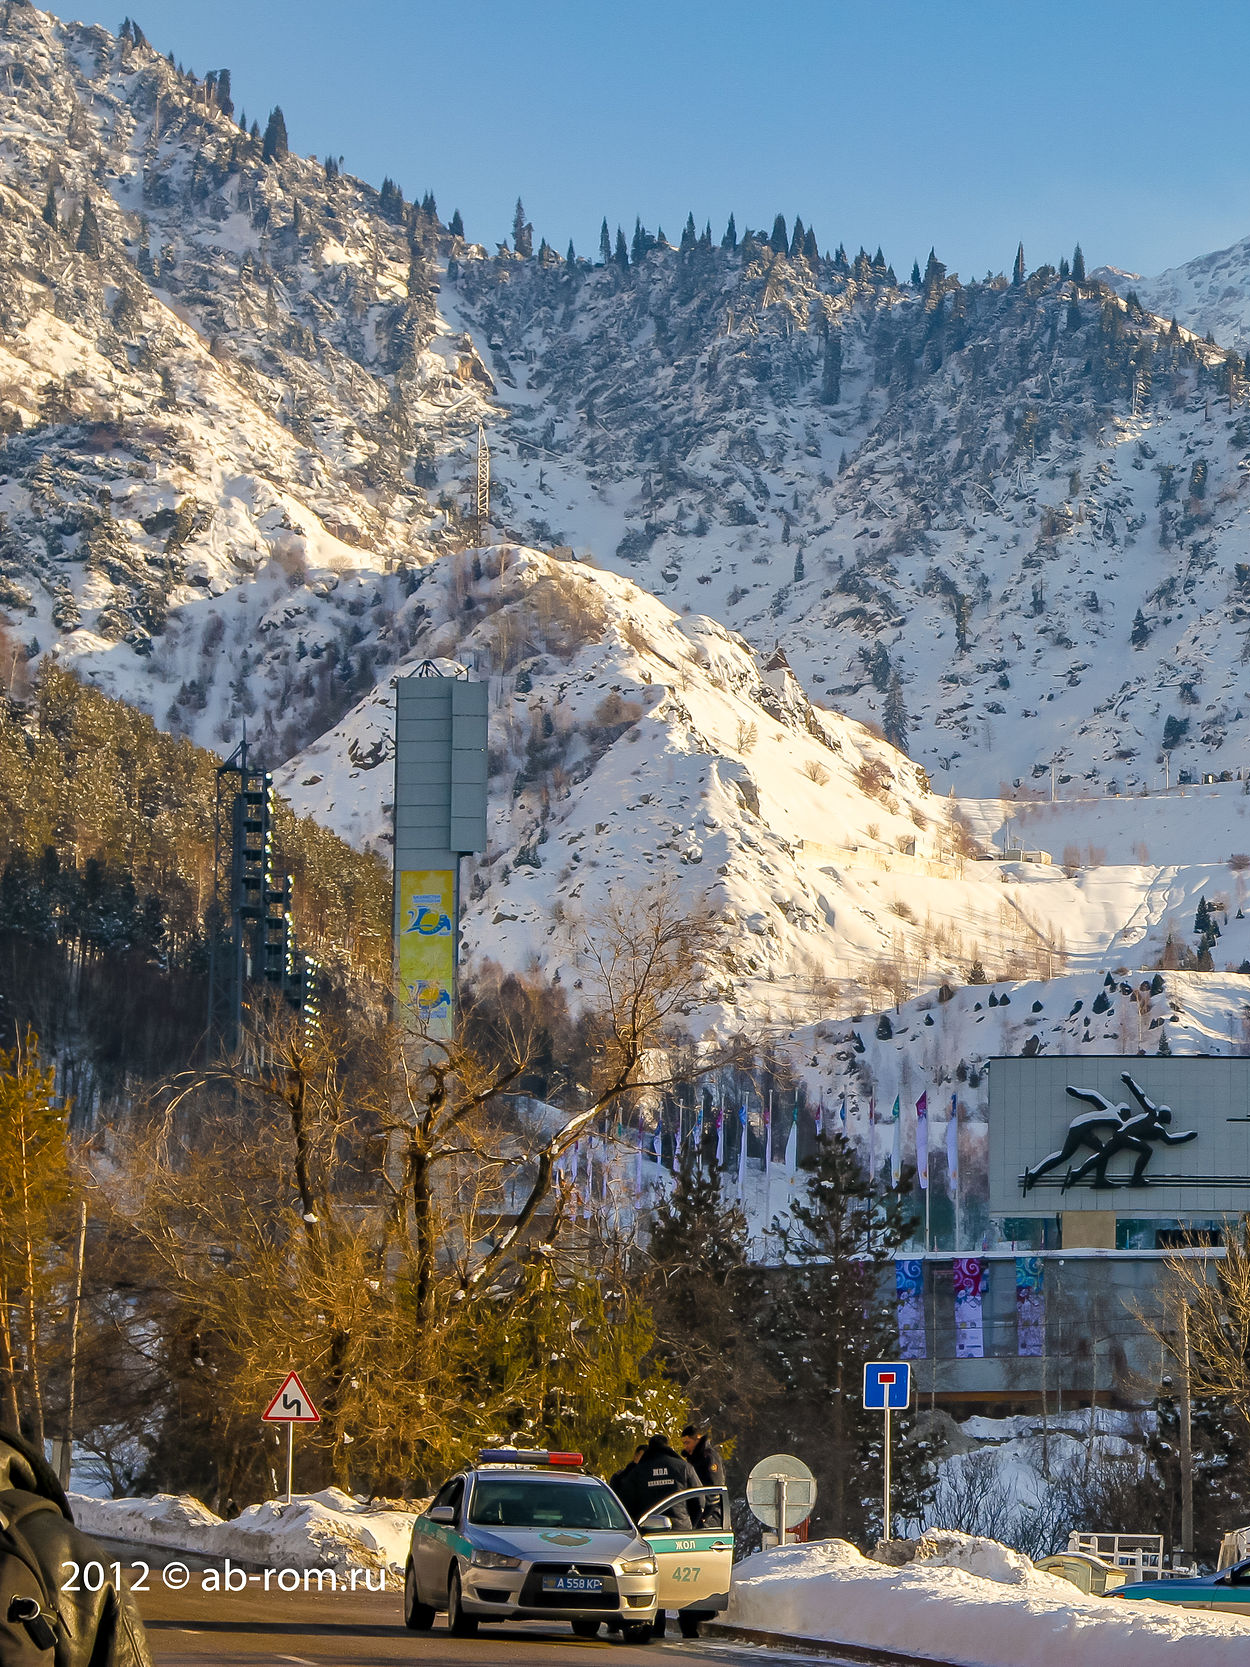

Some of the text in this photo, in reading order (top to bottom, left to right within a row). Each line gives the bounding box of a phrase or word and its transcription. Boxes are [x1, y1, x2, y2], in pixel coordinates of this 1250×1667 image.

[675, 1540, 696, 1550] ЖОЛ
[672, 1566, 701, 1582] 427
[557, 1578, 600, 1589] A 558 KP
